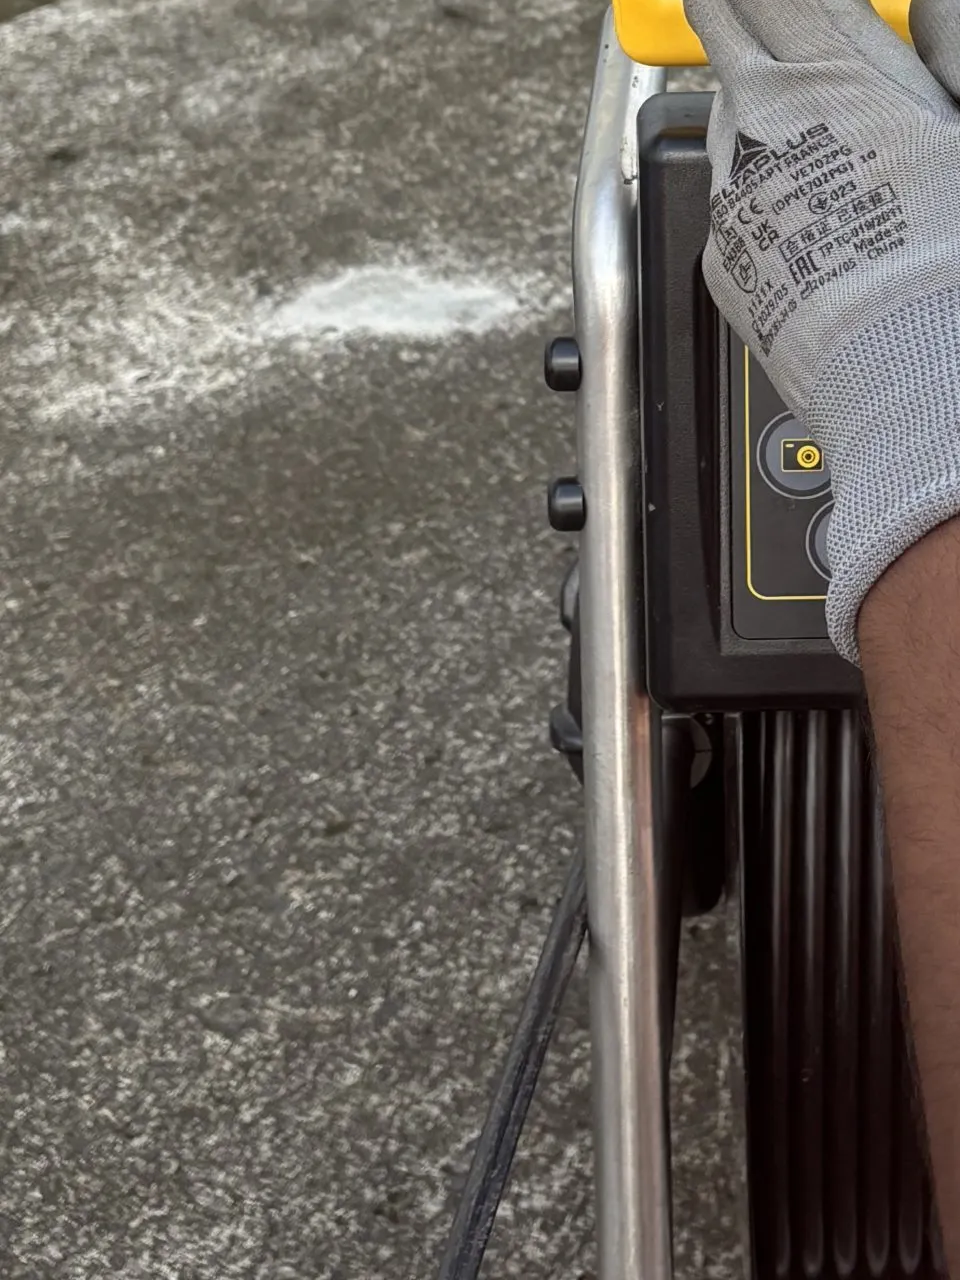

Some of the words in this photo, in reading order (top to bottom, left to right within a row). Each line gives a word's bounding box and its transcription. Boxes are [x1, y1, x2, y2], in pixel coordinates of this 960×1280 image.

[789, 144, 853, 182] VE702PG
[830, 180, 857, 201] 023
[751, 219, 773, 241] UK
[867, 236, 906, 260] China
